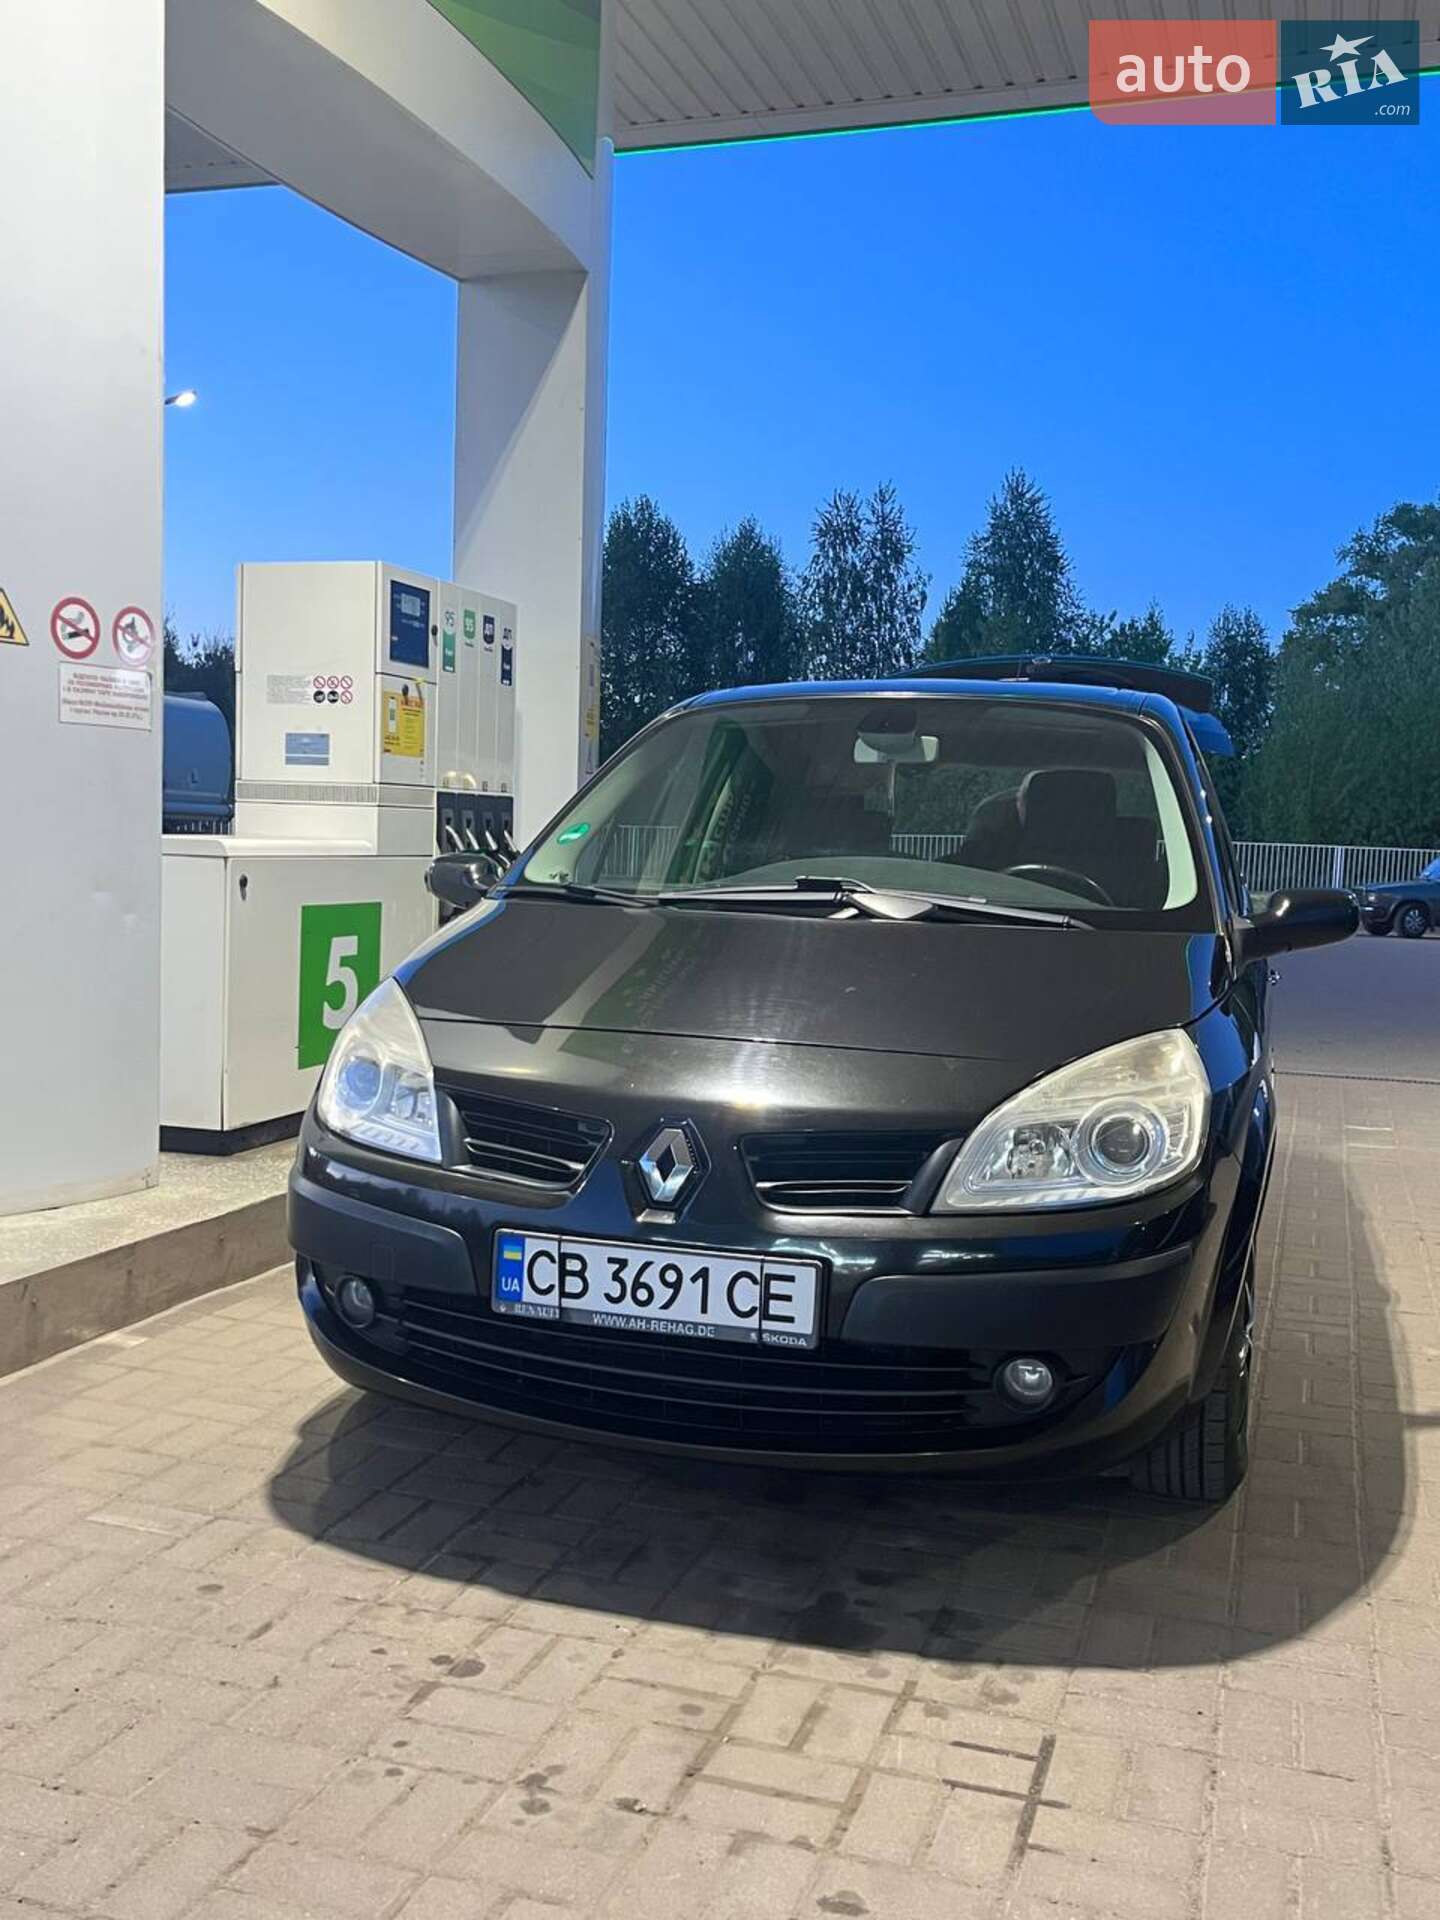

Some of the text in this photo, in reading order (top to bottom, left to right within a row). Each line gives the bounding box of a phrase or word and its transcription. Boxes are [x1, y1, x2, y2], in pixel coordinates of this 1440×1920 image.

[322, 935, 359, 1030] 5
[501, 1276, 521, 1292] UA
[526, 1249, 796, 1323] CB 3691 CE
[592, 1312, 716, 1337] WWW.AH-REHAG.DE
